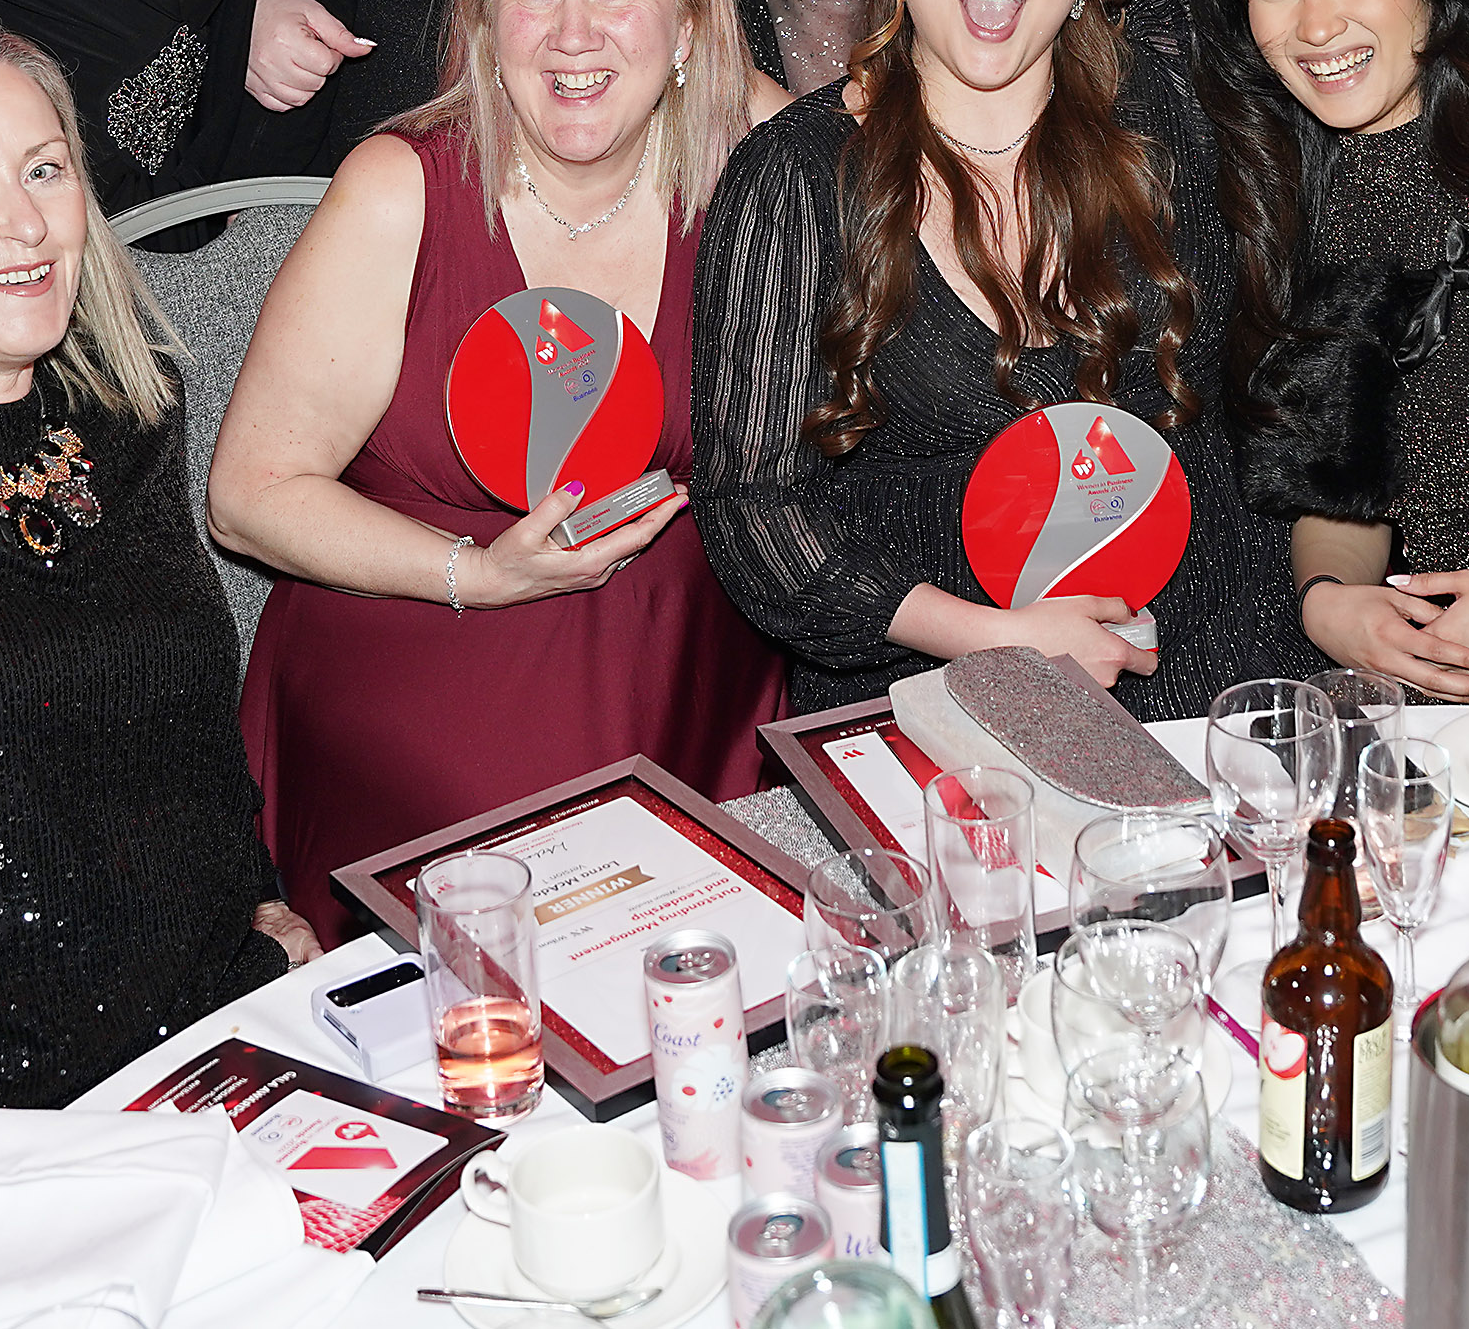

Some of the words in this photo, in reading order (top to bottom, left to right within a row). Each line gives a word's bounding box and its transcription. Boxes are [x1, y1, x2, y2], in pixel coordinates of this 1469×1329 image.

[572, 386, 598, 402] Business
[1093, 513, 1122, 523] Business
[548, 862, 586, 882] Version
[580, 858, 620, 879] Lorna
[529, 874, 579, 899] McAdo
[549, 876, 632, 915] WINNER
[702, 875, 730, 893] and
[631, 889, 702, 922] Leadership
[658, 884, 741, 924] Outstanding
[568, 919, 658, 963] Management
[654, 1022, 703, 1048] Coast
[267, 1069, 297, 1090] GALA
[228, 1084, 270, 1118] AWARDS
[844, 1232, 879, 1257] We
